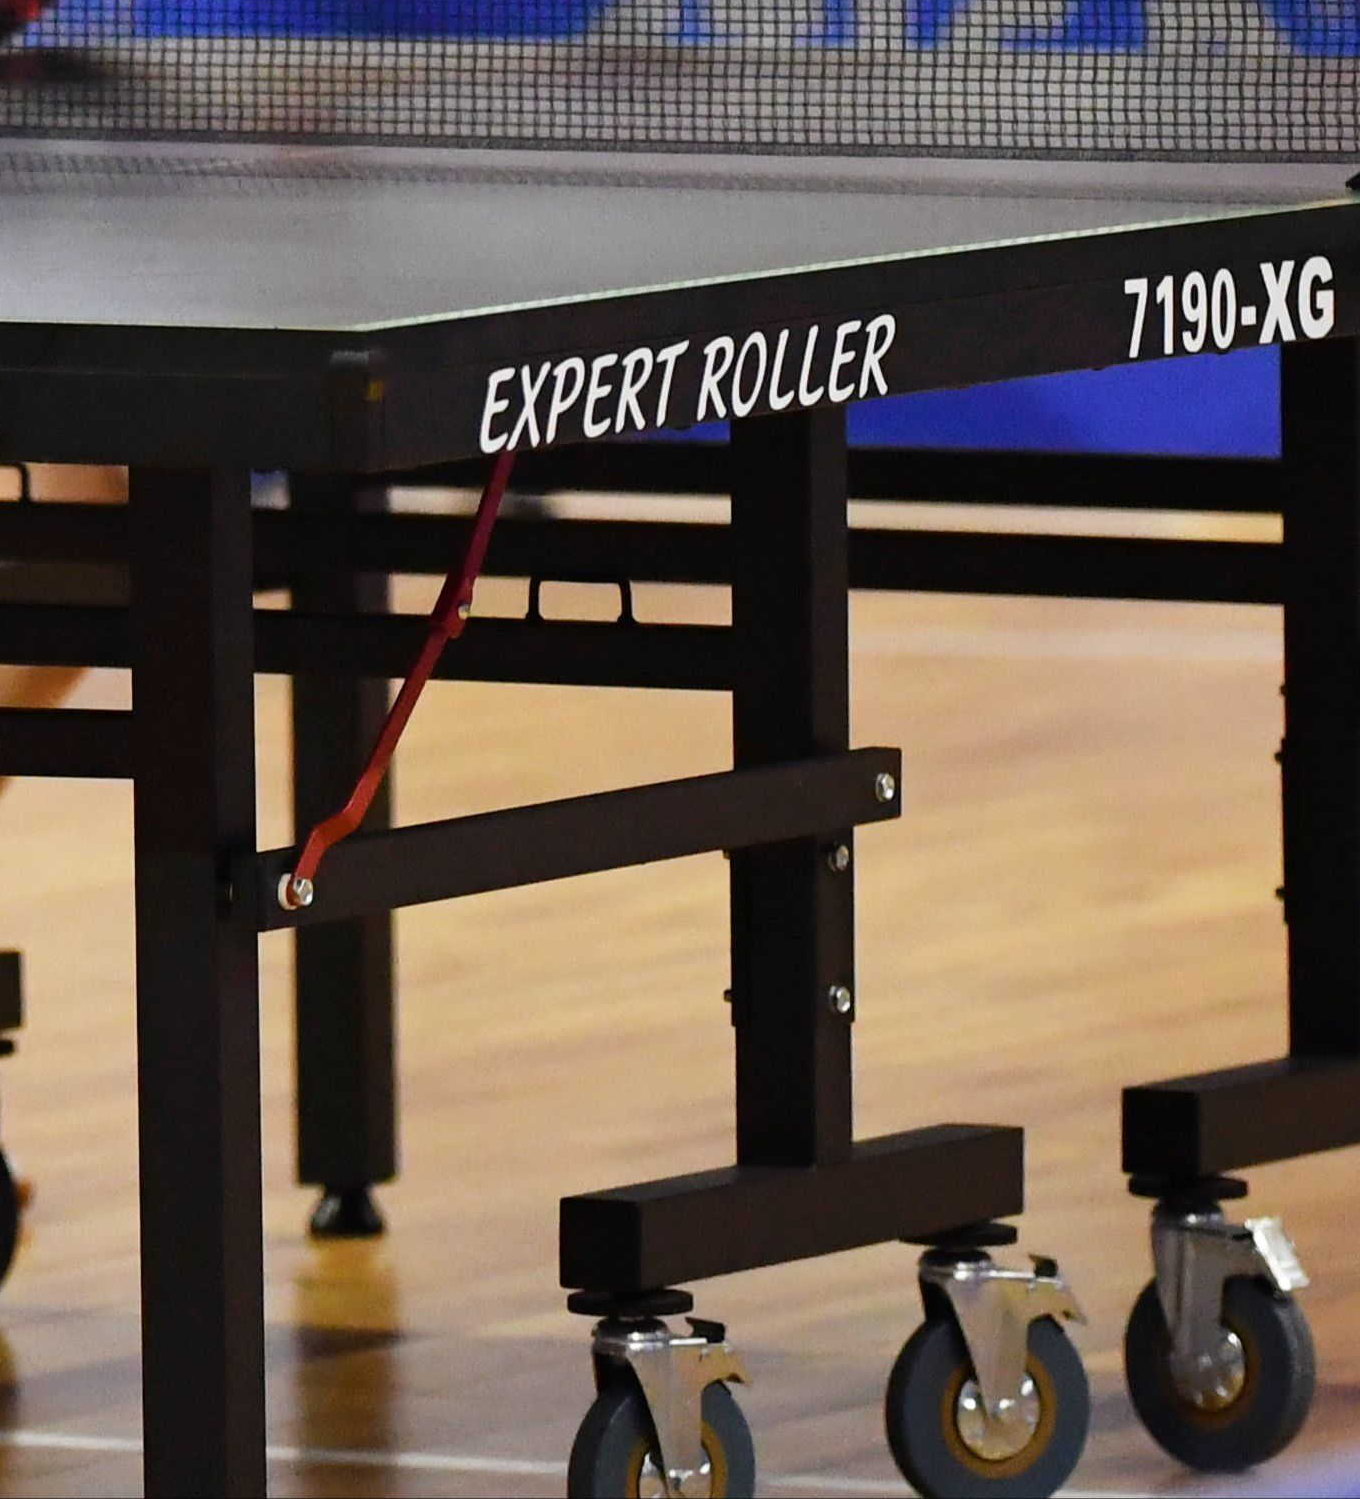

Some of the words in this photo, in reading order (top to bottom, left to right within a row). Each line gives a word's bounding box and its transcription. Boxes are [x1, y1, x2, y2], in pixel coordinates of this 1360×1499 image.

[1124, 256, 1336, 359] 7190-XG
[480, 340, 690, 455] EXPERT
[697, 313, 896, 424] ROLLER
